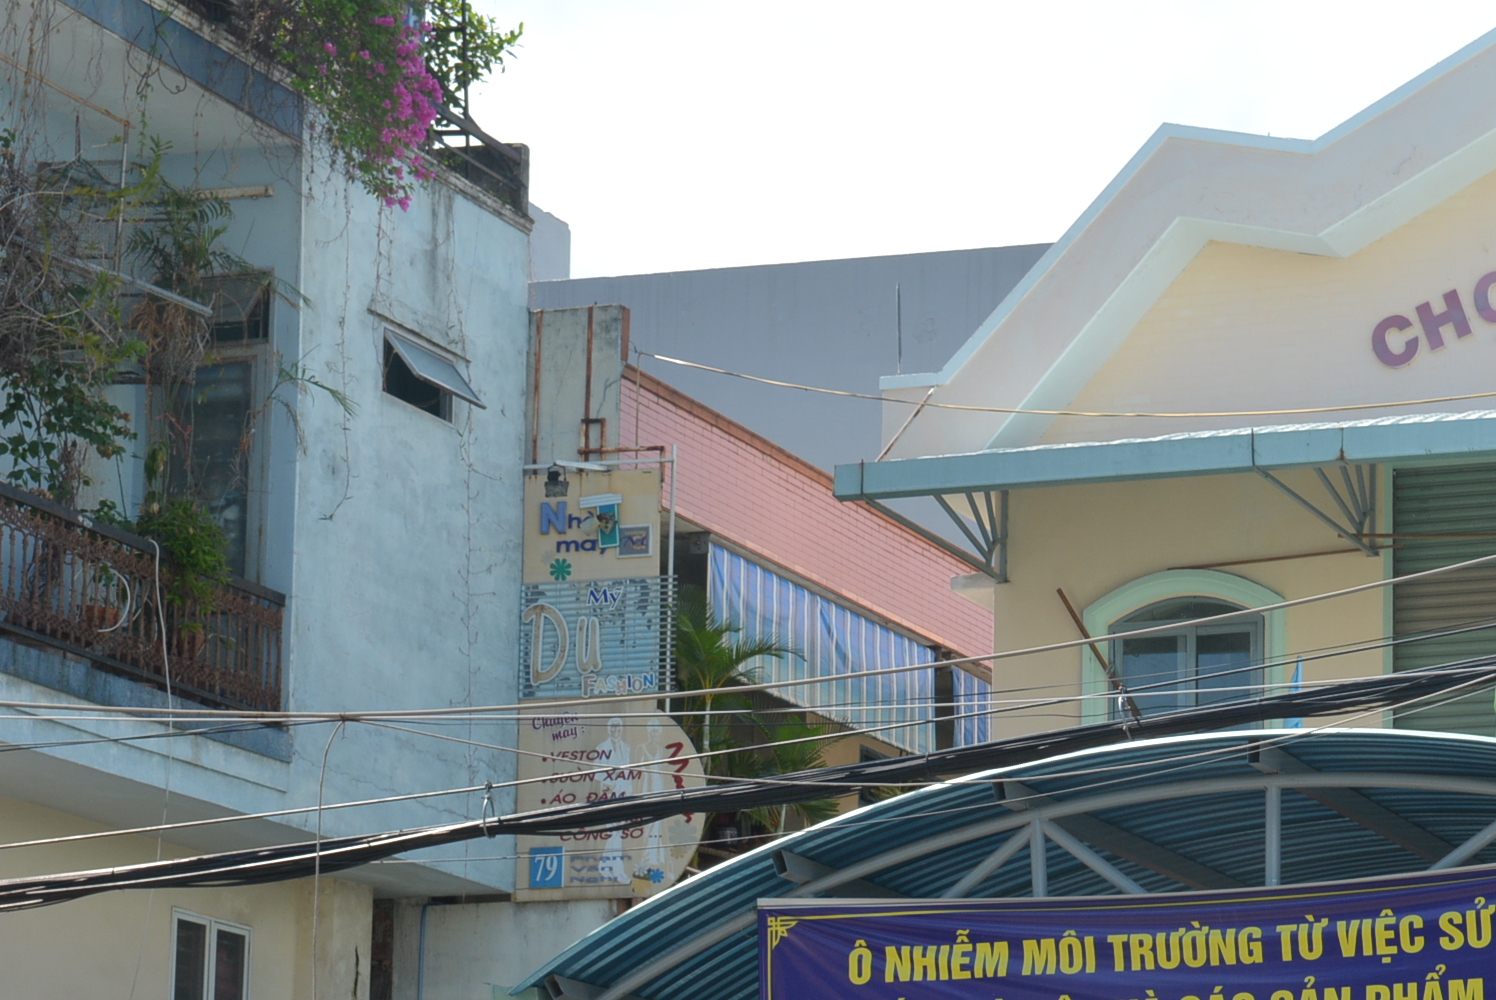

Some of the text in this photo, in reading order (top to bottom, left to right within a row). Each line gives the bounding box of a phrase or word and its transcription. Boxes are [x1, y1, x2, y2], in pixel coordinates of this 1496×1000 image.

[587, 587, 623, 610] Mỹ
[581, 672, 655, 698] FASHION
[550, 749, 613, 763] VESTON
[549, 789, 576, 805] ÁO
[534, 855, 558, 882] 79
[848, 939, 873, 985] Ô
[884, 929, 1009, 984] NHIỄM
[1021, 930, 1096, 976] MÔI
[1107, 921, 1263, 972] TRƯỜNG
[1275, 914, 1329, 962] TỪ
[1336, 909, 1425, 964] VIỆC
[1438, 897, 1496, 951] SỬ
